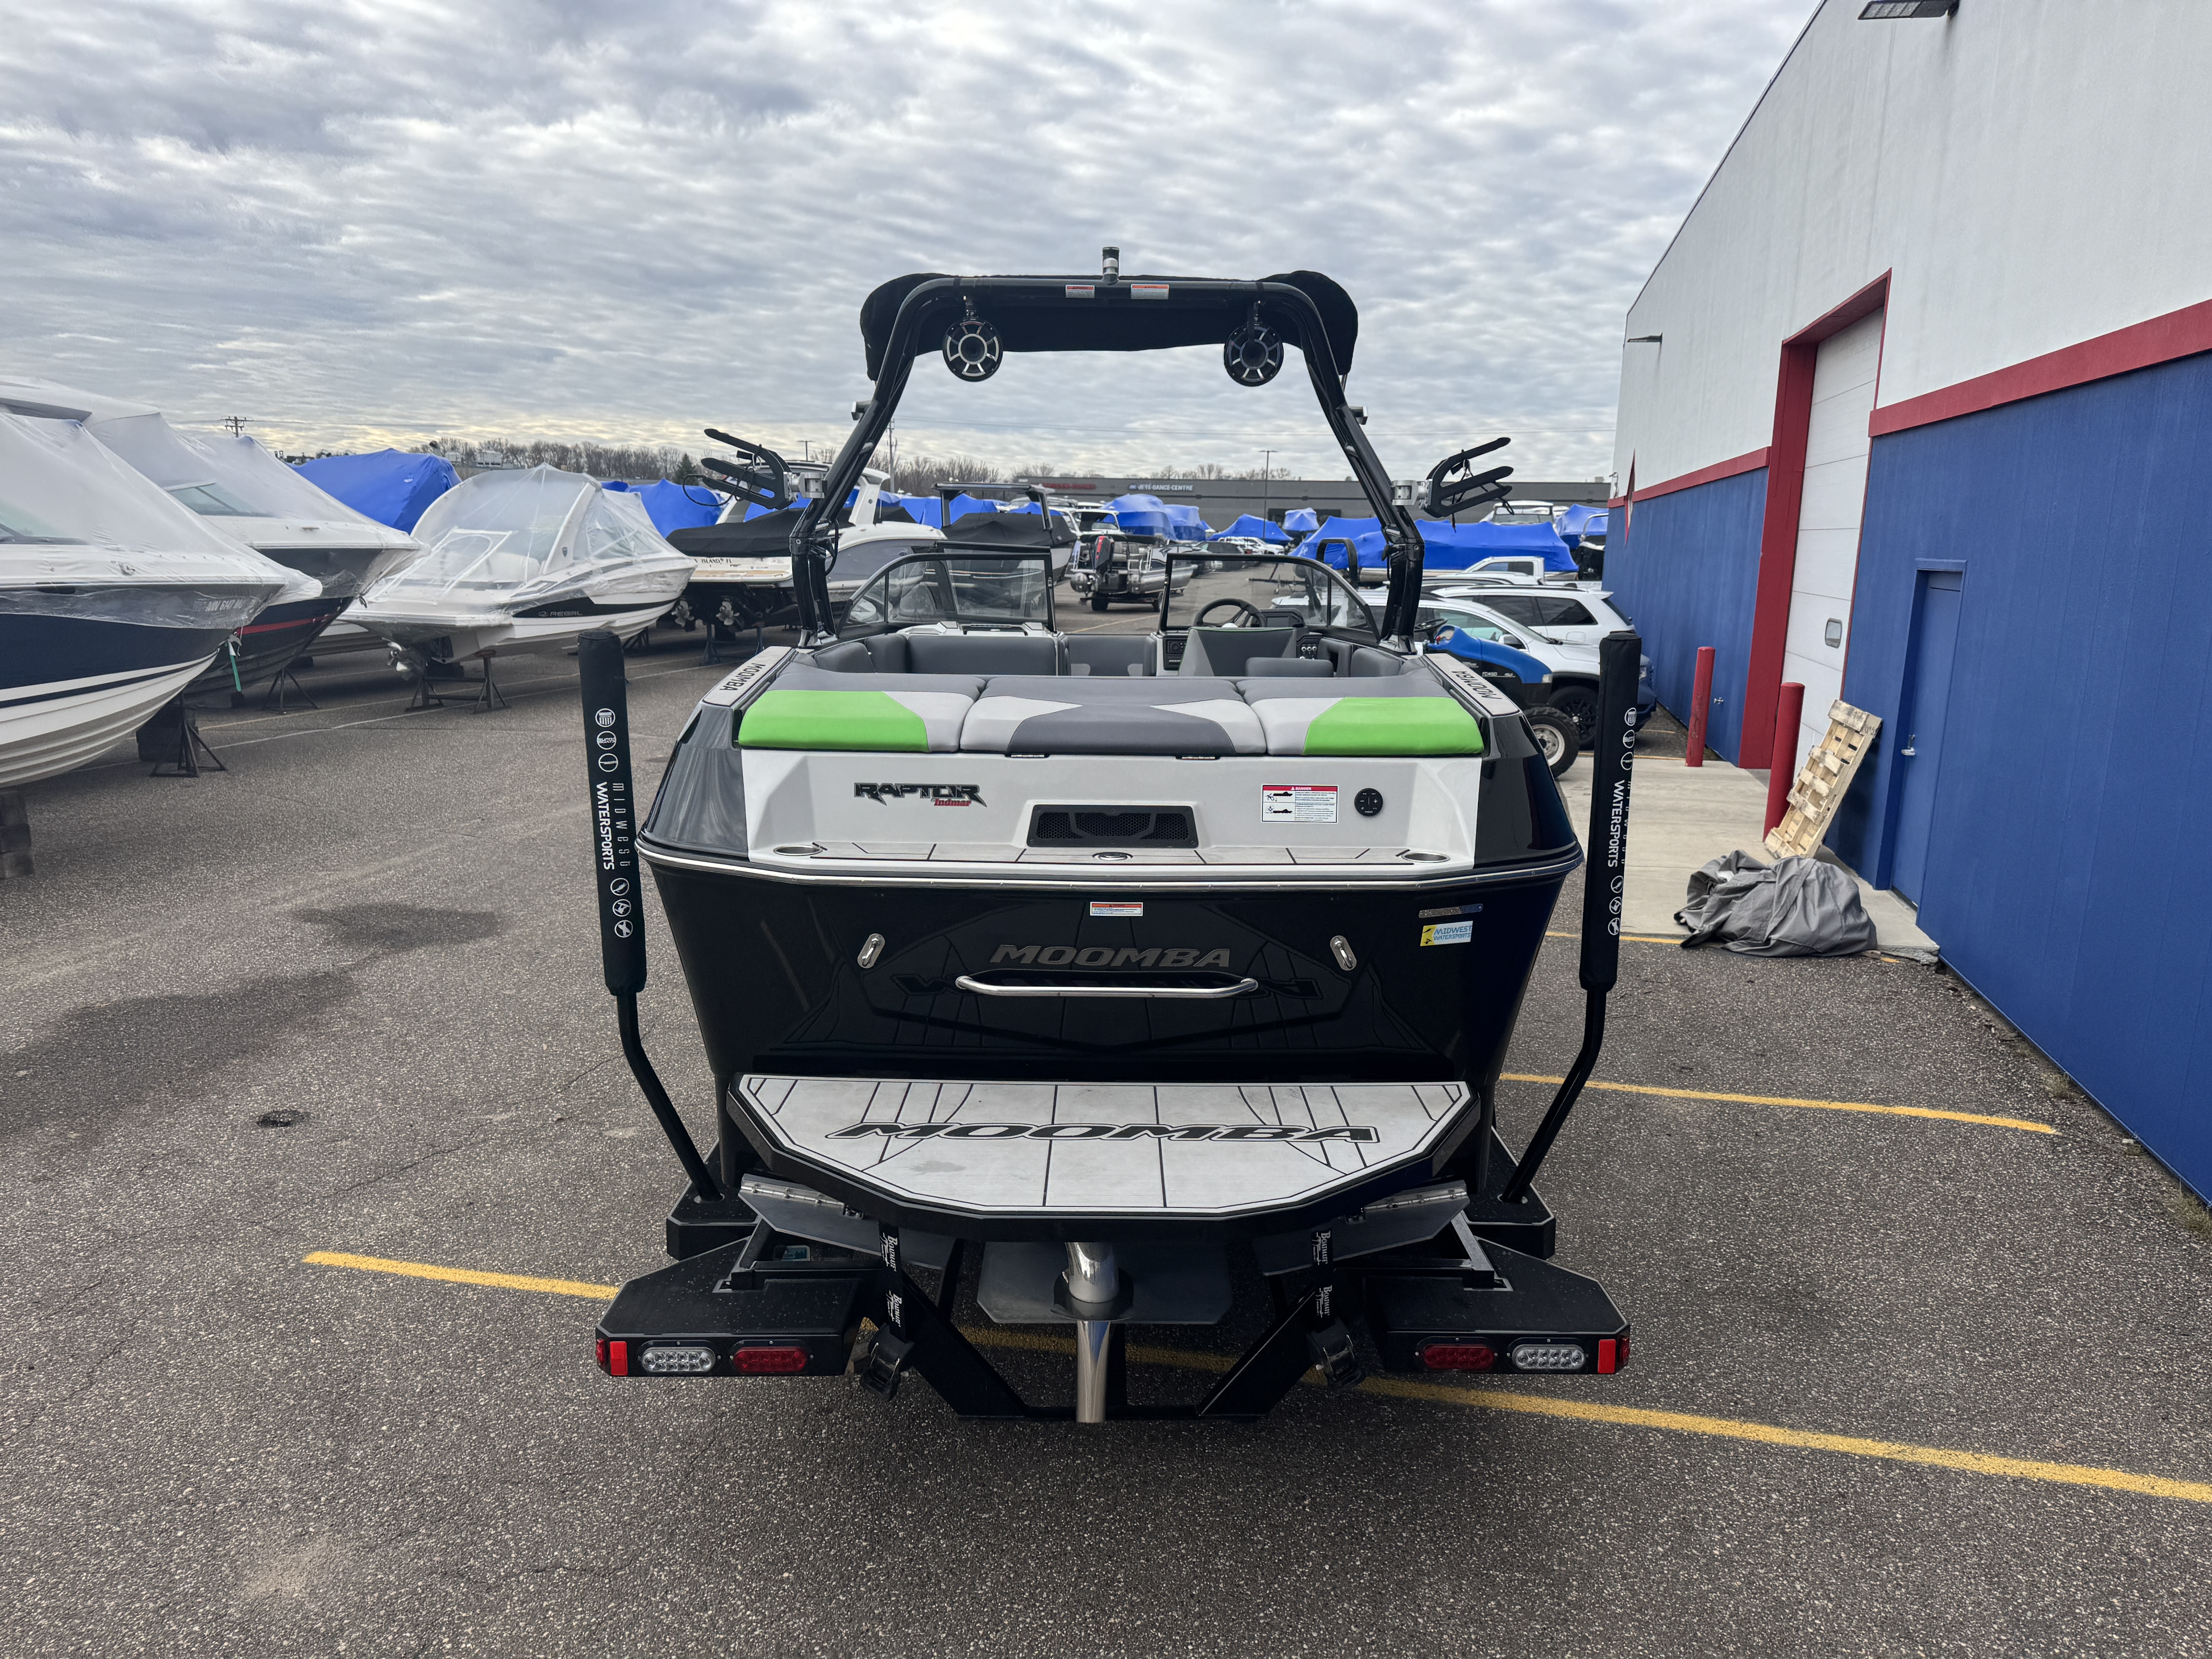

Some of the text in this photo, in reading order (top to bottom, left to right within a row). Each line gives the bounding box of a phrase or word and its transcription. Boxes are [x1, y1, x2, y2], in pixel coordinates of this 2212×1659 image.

[719, 663, 766, 690] MOOMBA
[1451, 671, 1503, 700] MOOMBA
[854, 782, 988, 808] RAPTOR
[596, 781, 615, 871] WATERSPORTS
[1607, 780, 1625, 868] WATERSPORTS
[1432, 933, 1472, 941] WATERSPORTS
[1434, 925, 1472, 935] MIDWEST
[989, 944, 1231, 967] MOOMBA
[824, 1122, 1381, 1144] MOOMBA
